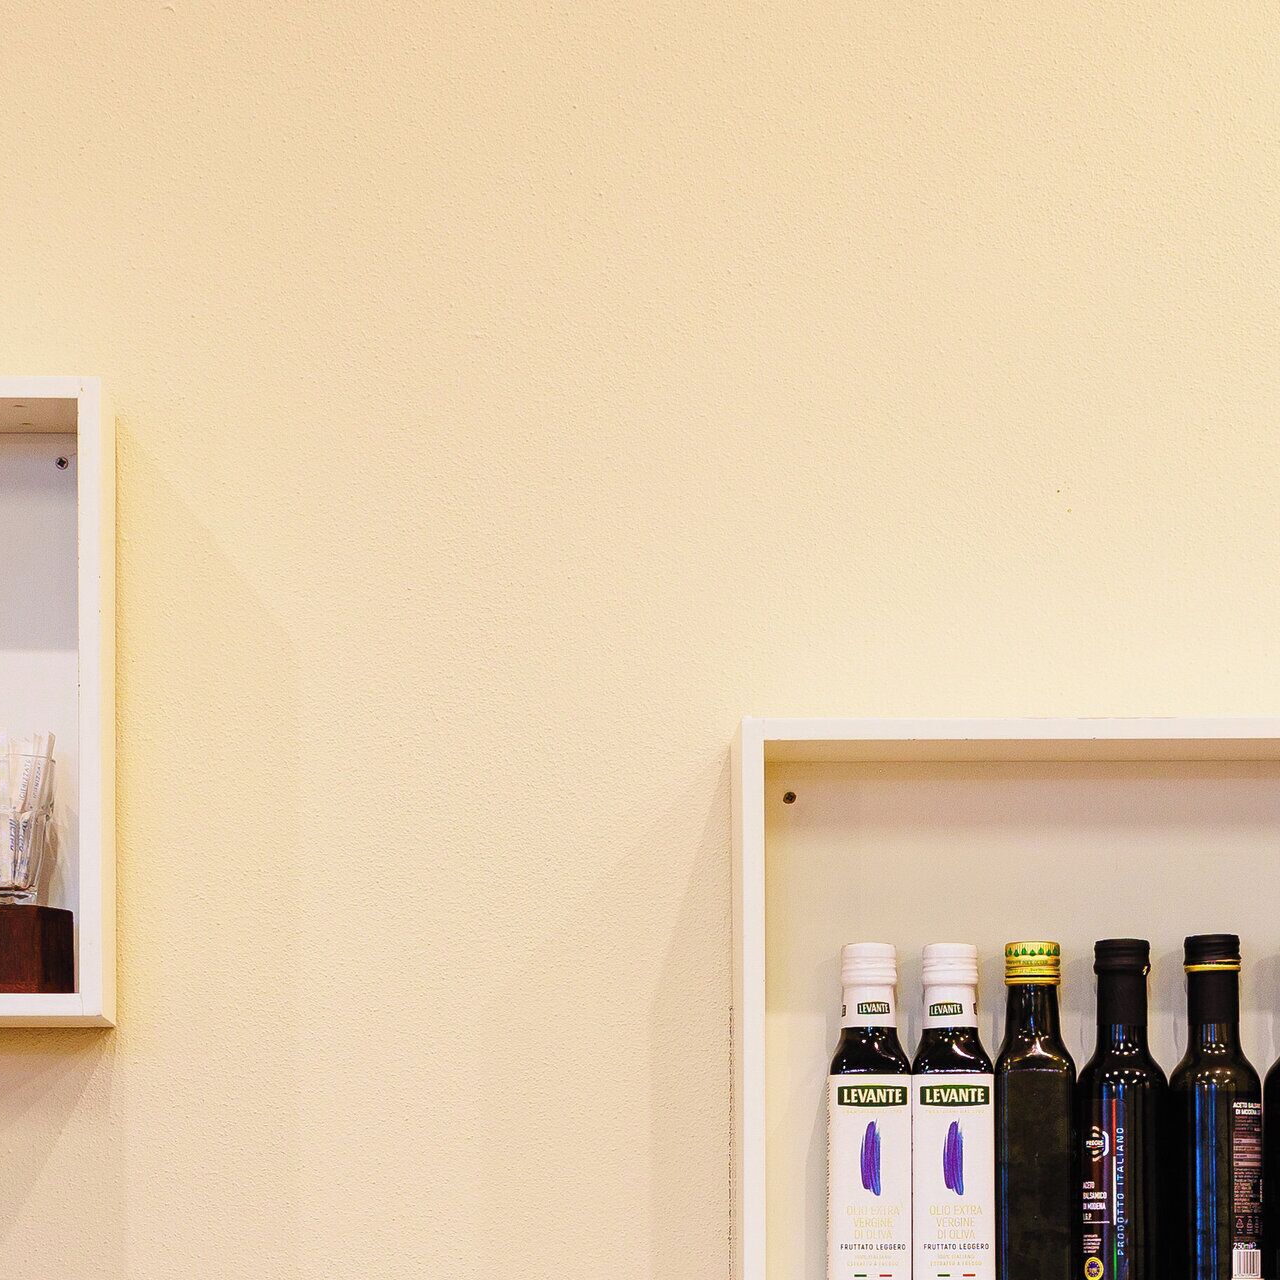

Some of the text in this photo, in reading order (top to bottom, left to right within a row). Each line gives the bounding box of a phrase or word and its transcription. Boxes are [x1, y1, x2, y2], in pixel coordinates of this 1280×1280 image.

[858, 1003, 890, 1013] LEVANTE
[930, 1004, 963, 1015] LEVANTE
[843, 1087, 902, 1103] LEVANTE
[925, 1087, 985, 1103] LEVANTE
[1116, 1127, 1125, 1256] PRODOTTO ITALIANO
[929, 1205, 983, 1215] OLIO EXTRA
[853, 1217, 893, 1227] VERGINE
[936, 1217, 975, 1227] VERGINE
[854, 1230, 863, 1239] DI
[937, 1229, 976, 1239] DI OLIVA
